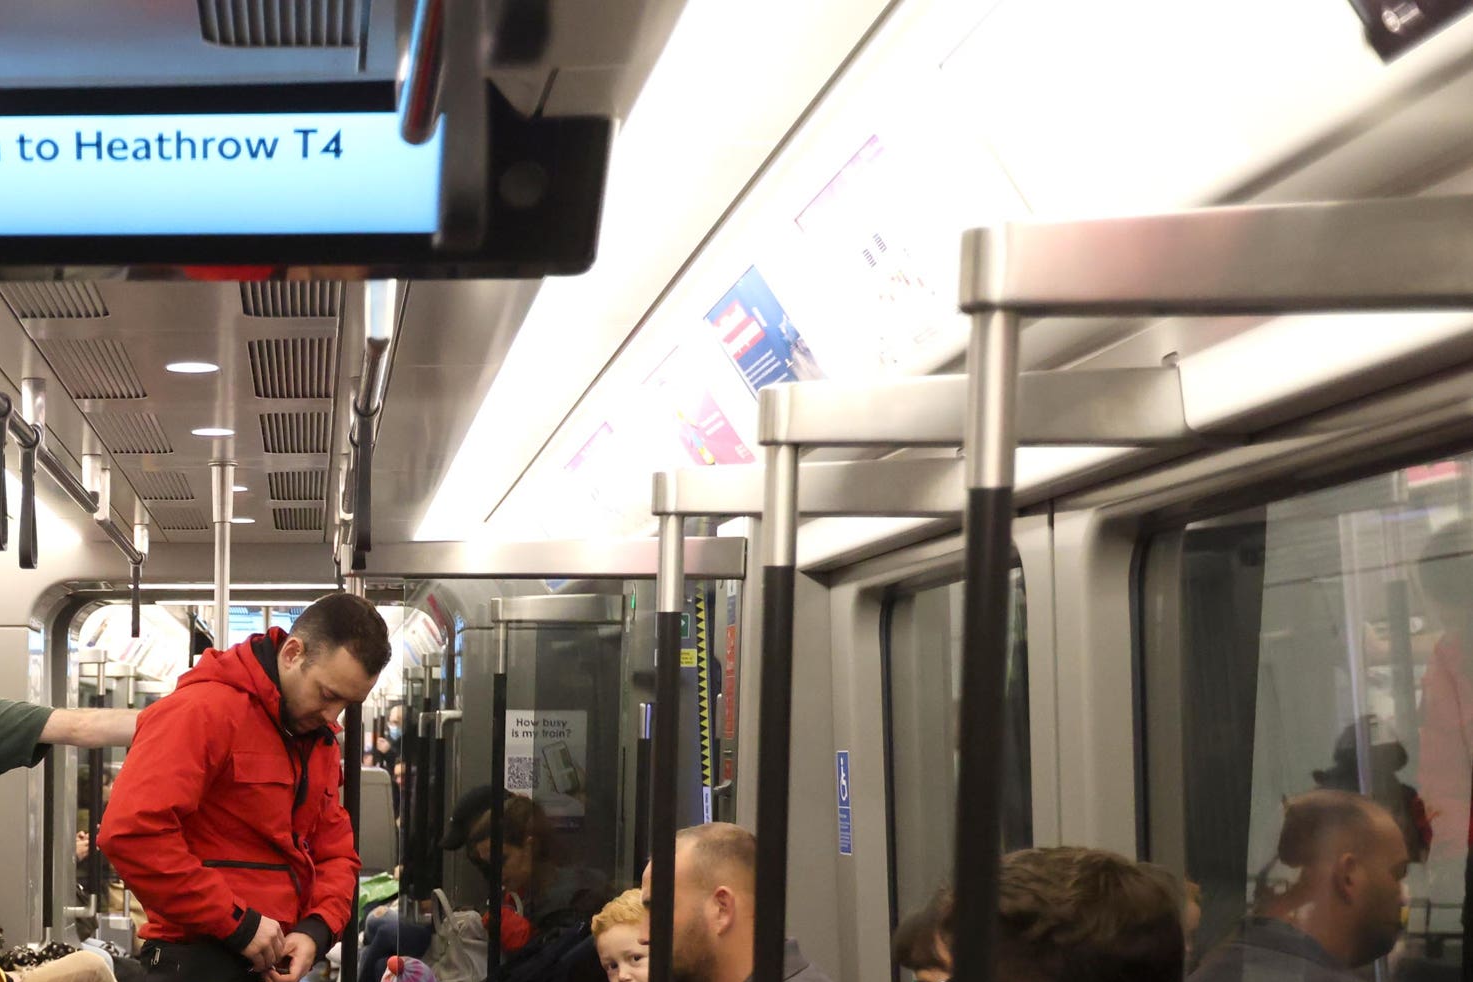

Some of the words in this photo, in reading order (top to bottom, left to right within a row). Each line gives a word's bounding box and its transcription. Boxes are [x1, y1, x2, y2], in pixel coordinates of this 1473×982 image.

[16, 133, 60, 162] to
[75, 130, 280, 161] Heathrow
[293, 128, 344, 160] T4
[516, 718, 539, 728] How
[542, 718, 568, 730] busy
[511, 729, 519, 738] is
[522, 730, 538, 740] my
[542, 728, 572, 738] train?
